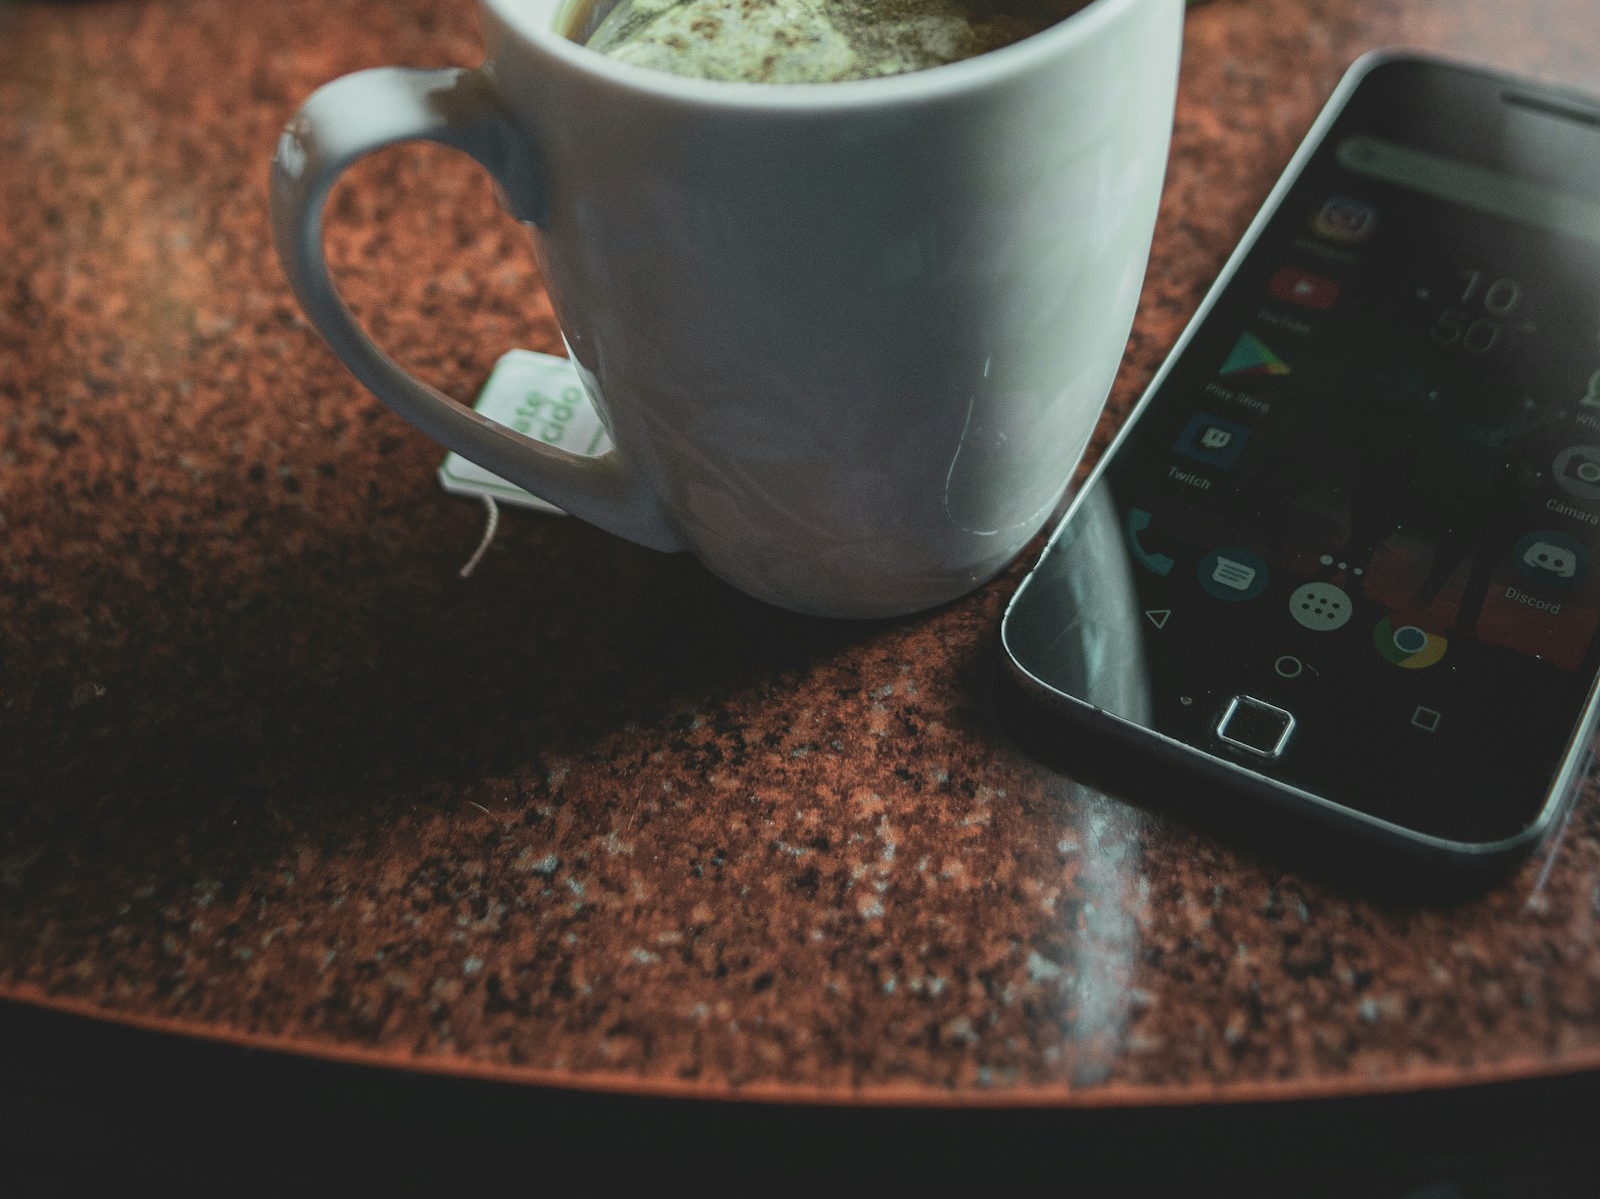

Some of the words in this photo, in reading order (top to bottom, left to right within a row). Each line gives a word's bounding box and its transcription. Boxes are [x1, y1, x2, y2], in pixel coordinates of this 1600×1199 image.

[1461, 270, 1520, 316] 10
[1205, 381, 1233, 401] Play
[1237, 391, 1272, 414] Store
[1167, 465, 1211, 491] Twitch
[1546, 498, 1600, 526] Cámara
[1504, 585, 1561, 615] Discord
